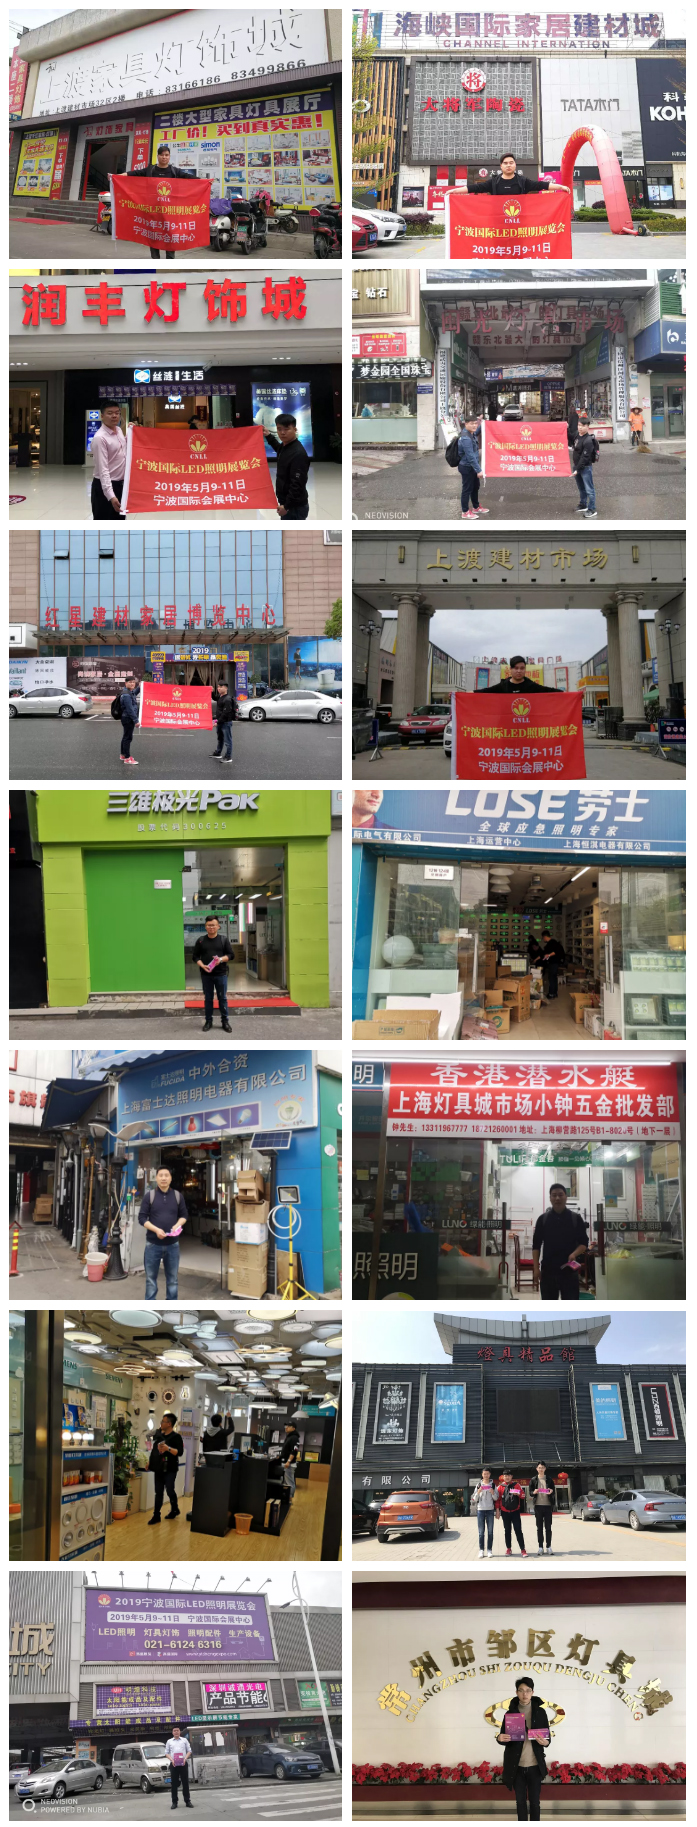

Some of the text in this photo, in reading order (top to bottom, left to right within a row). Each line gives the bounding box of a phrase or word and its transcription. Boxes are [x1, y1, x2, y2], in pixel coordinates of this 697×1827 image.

[393, 12, 662, 38] 海峡国际家居建材城
[443, 40, 610, 48] CHANNEL INTERNATION
[165, 75, 221, 93] 83166186
[231, 59, 306, 80] 83499866
[160, 94, 321, 127] 二楼大型家具灯具展厅
[421, 96, 525, 112] 大将军陶瓷
[119, 199, 207, 215] 宁波国际LED照明展览会
[134, 216, 196, 231] 2019年5月9-11日
[454, 222, 566, 238] 宁波国际LED照明展览会
[133, 226, 196, 244] 宁波国际会展中心
[472, 242, 551, 256] 2019年5月9-11日
[366, 287, 388, 299] 钻石
[22, 276, 308, 326] 润丰灯饰城
[181, 370, 204, 381] 生活
[136, 457, 261, 475] 宁波国际LED照明展览会
[500, 463, 556, 472] 宁波国际会展中心
[154, 479, 246, 493] 2019年5月9-11日
[153, 494, 249, 507] 宁波国际会展中心
[426, 548, 609, 570] 上渡建材市场
[45, 603, 275, 628] 红星建材家居博览中心
[154, 711, 199, 719] 2019年5月9-11日
[461, 724, 578, 739] 宁波国际LED照明展览会
[478, 745, 563, 759] 2019年5月9-11日
[478, 760, 564, 774] 宁波国际会展中心
[445, 790, 571, 820] LOSE
[137, 822, 226, 832] 股票代码300625
[478, 820, 619, 837] 全球应急照明专家
[353, 830, 422, 841] 际电气有限公司
[467, 835, 522, 847] 上海运营中心
[563, 839, 651, 851] 上海恒淇电器有限公司
[188, 1053, 249, 1081] 中外合资
[353, 1064, 374, 1084] 明
[160, 1076, 185, 1087] FUCIDA
[430, 1063, 638, 1087] 香港潜水艇
[121, 1063, 307, 1116] 上海富士达照明电器有限公司
[392, 1090, 675, 1118] 上海灯具城市场小钟五金批发部
[421, 1124, 468, 1133] 13311967777
[353, 1252, 418, 1281] 照明
[477, 1346, 575, 1363] 燈具精品館
[362, 1474, 431, 1486] 有限公司
[115, 1597, 256, 1611] 2019宁波国际LED照明展览会
[187, 1615, 250, 1624] 宁波国际会展中心
[9, 1621, 55, 1656] 城
[98, 1627, 261, 1638] LED照明 灯具灯饰 照明配件 生产设备
[198, 1640, 222, 1649] 6316
[377, 1628, 673, 1717] 常州市邹区灯具城
[405, 1661, 644, 1723] CHANGZHOU SHI ZOUQU DENGJU CHENG
